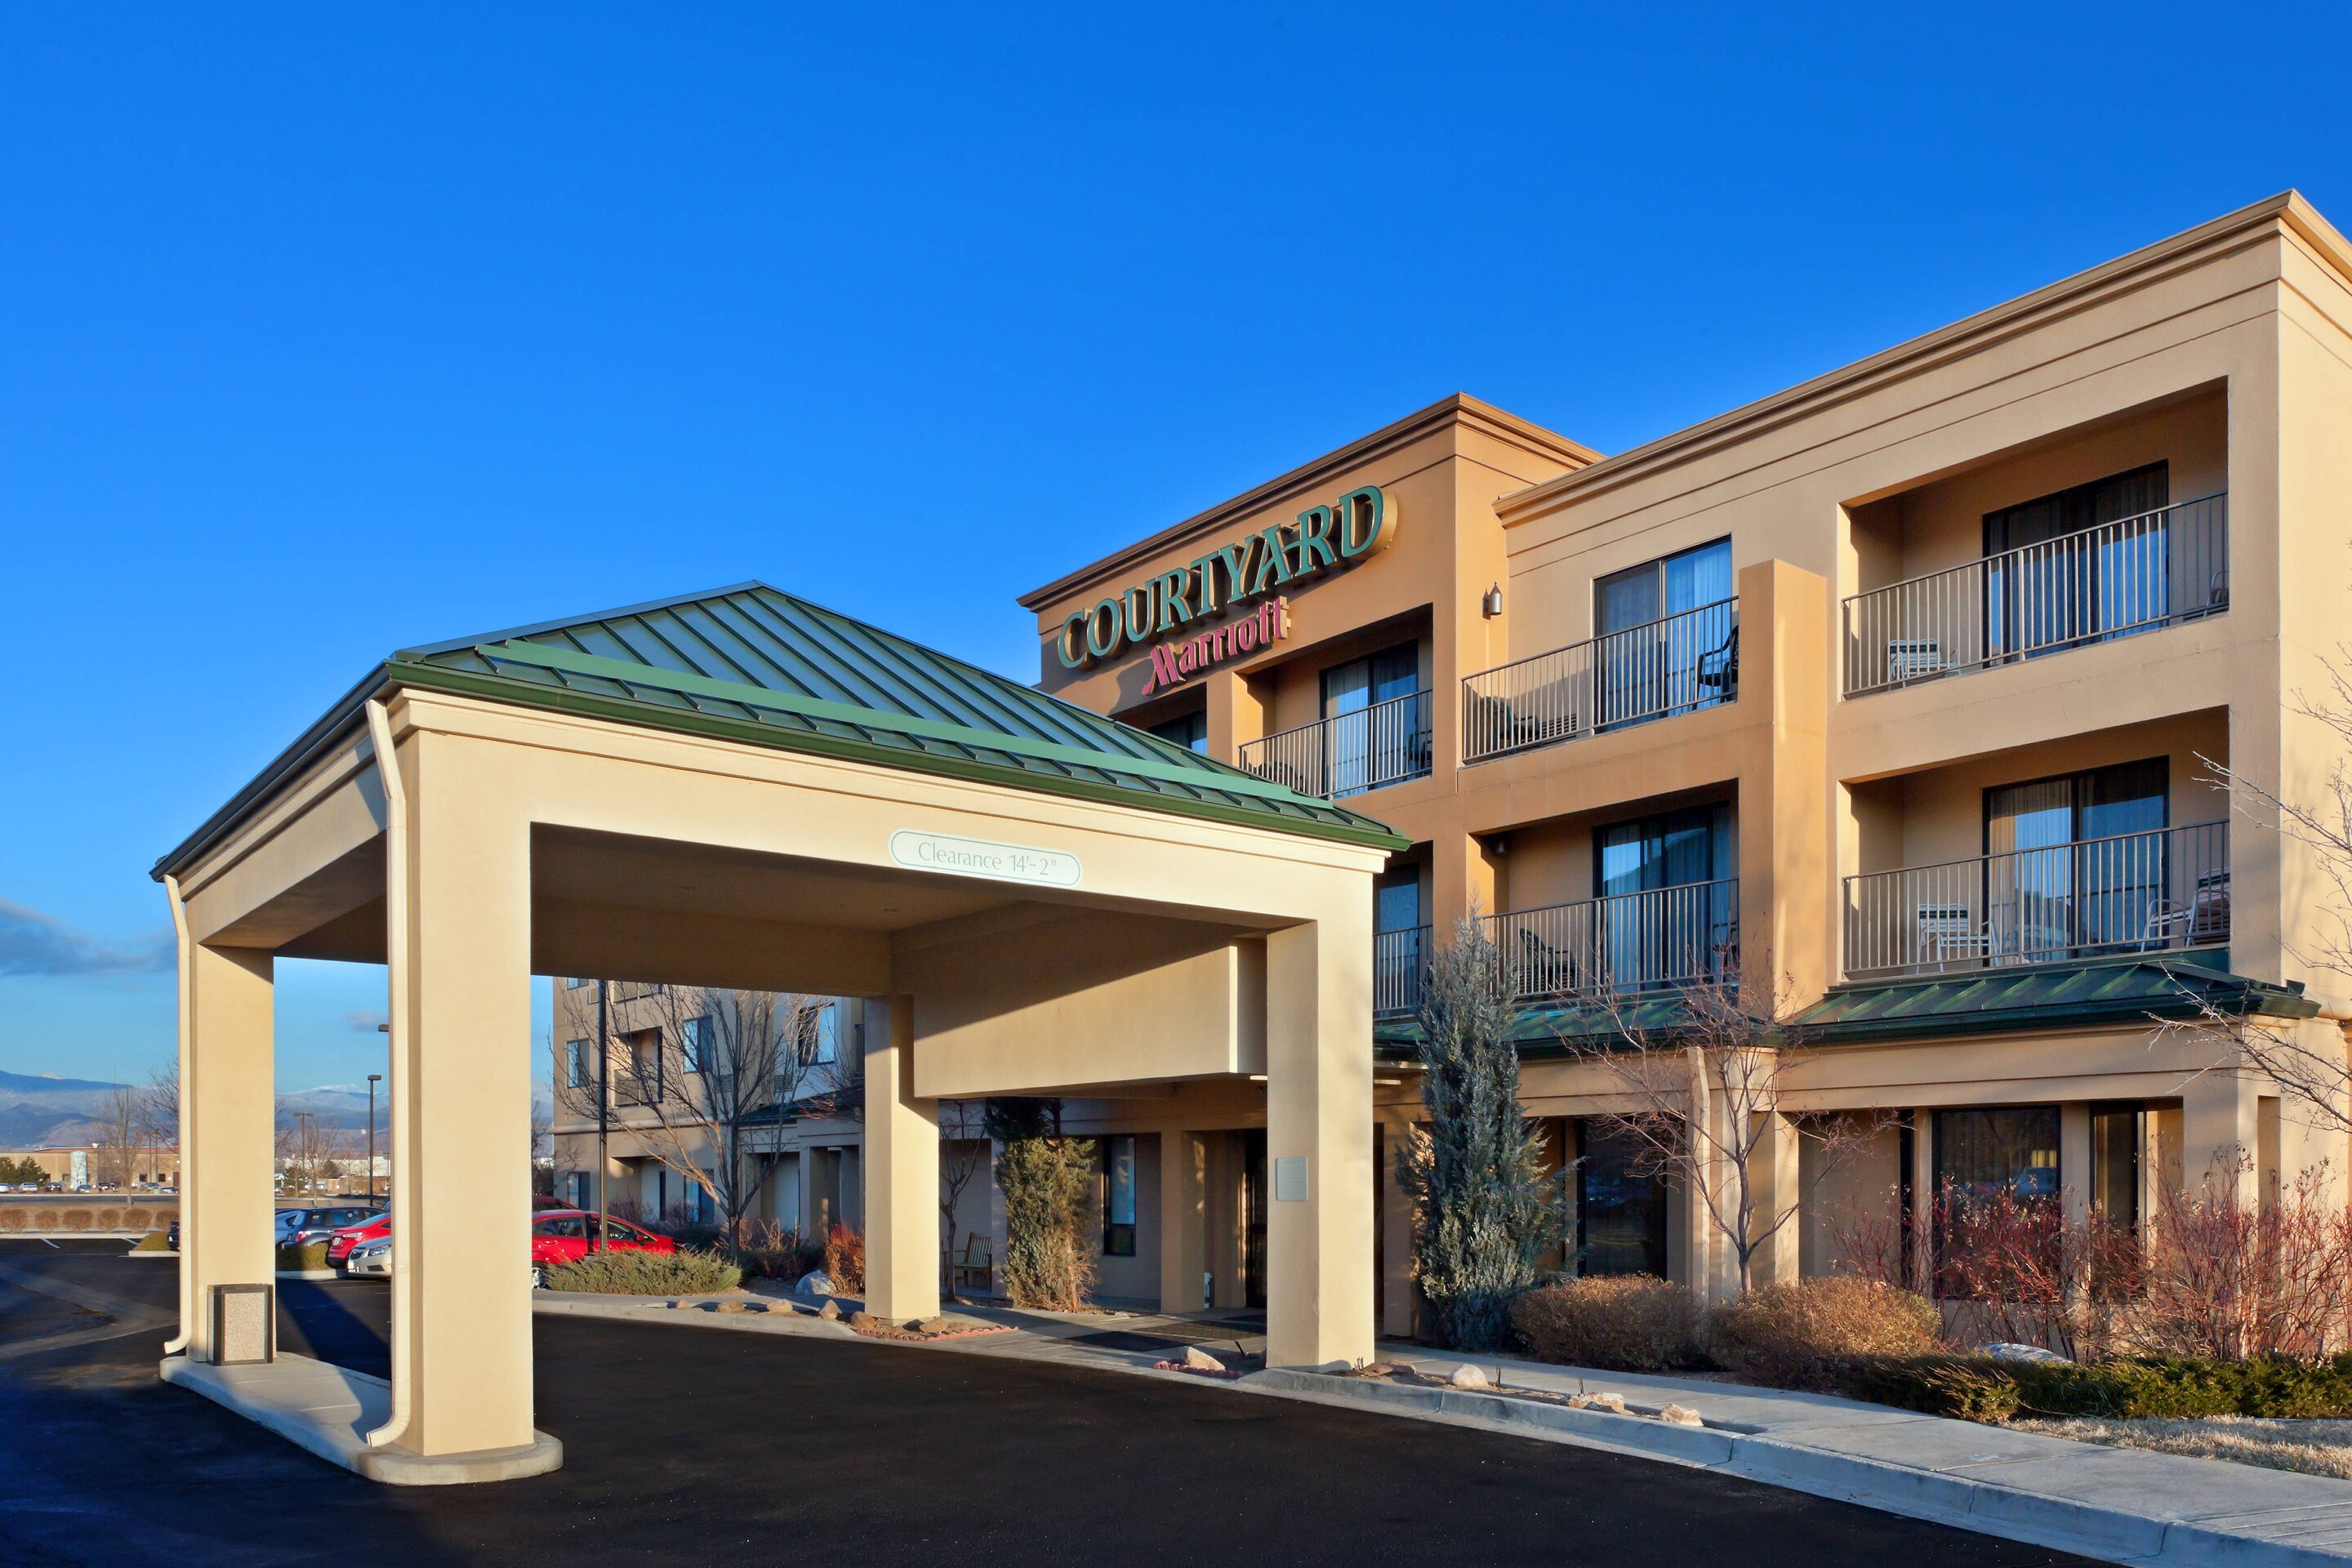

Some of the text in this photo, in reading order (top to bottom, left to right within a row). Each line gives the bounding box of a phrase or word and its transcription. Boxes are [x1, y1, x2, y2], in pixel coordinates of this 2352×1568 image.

[1058, 485, 1388, 669] COURTYARD
[1142, 596, 1288, 695] Marriott
[918, 842, 1002, 871] Clearance
